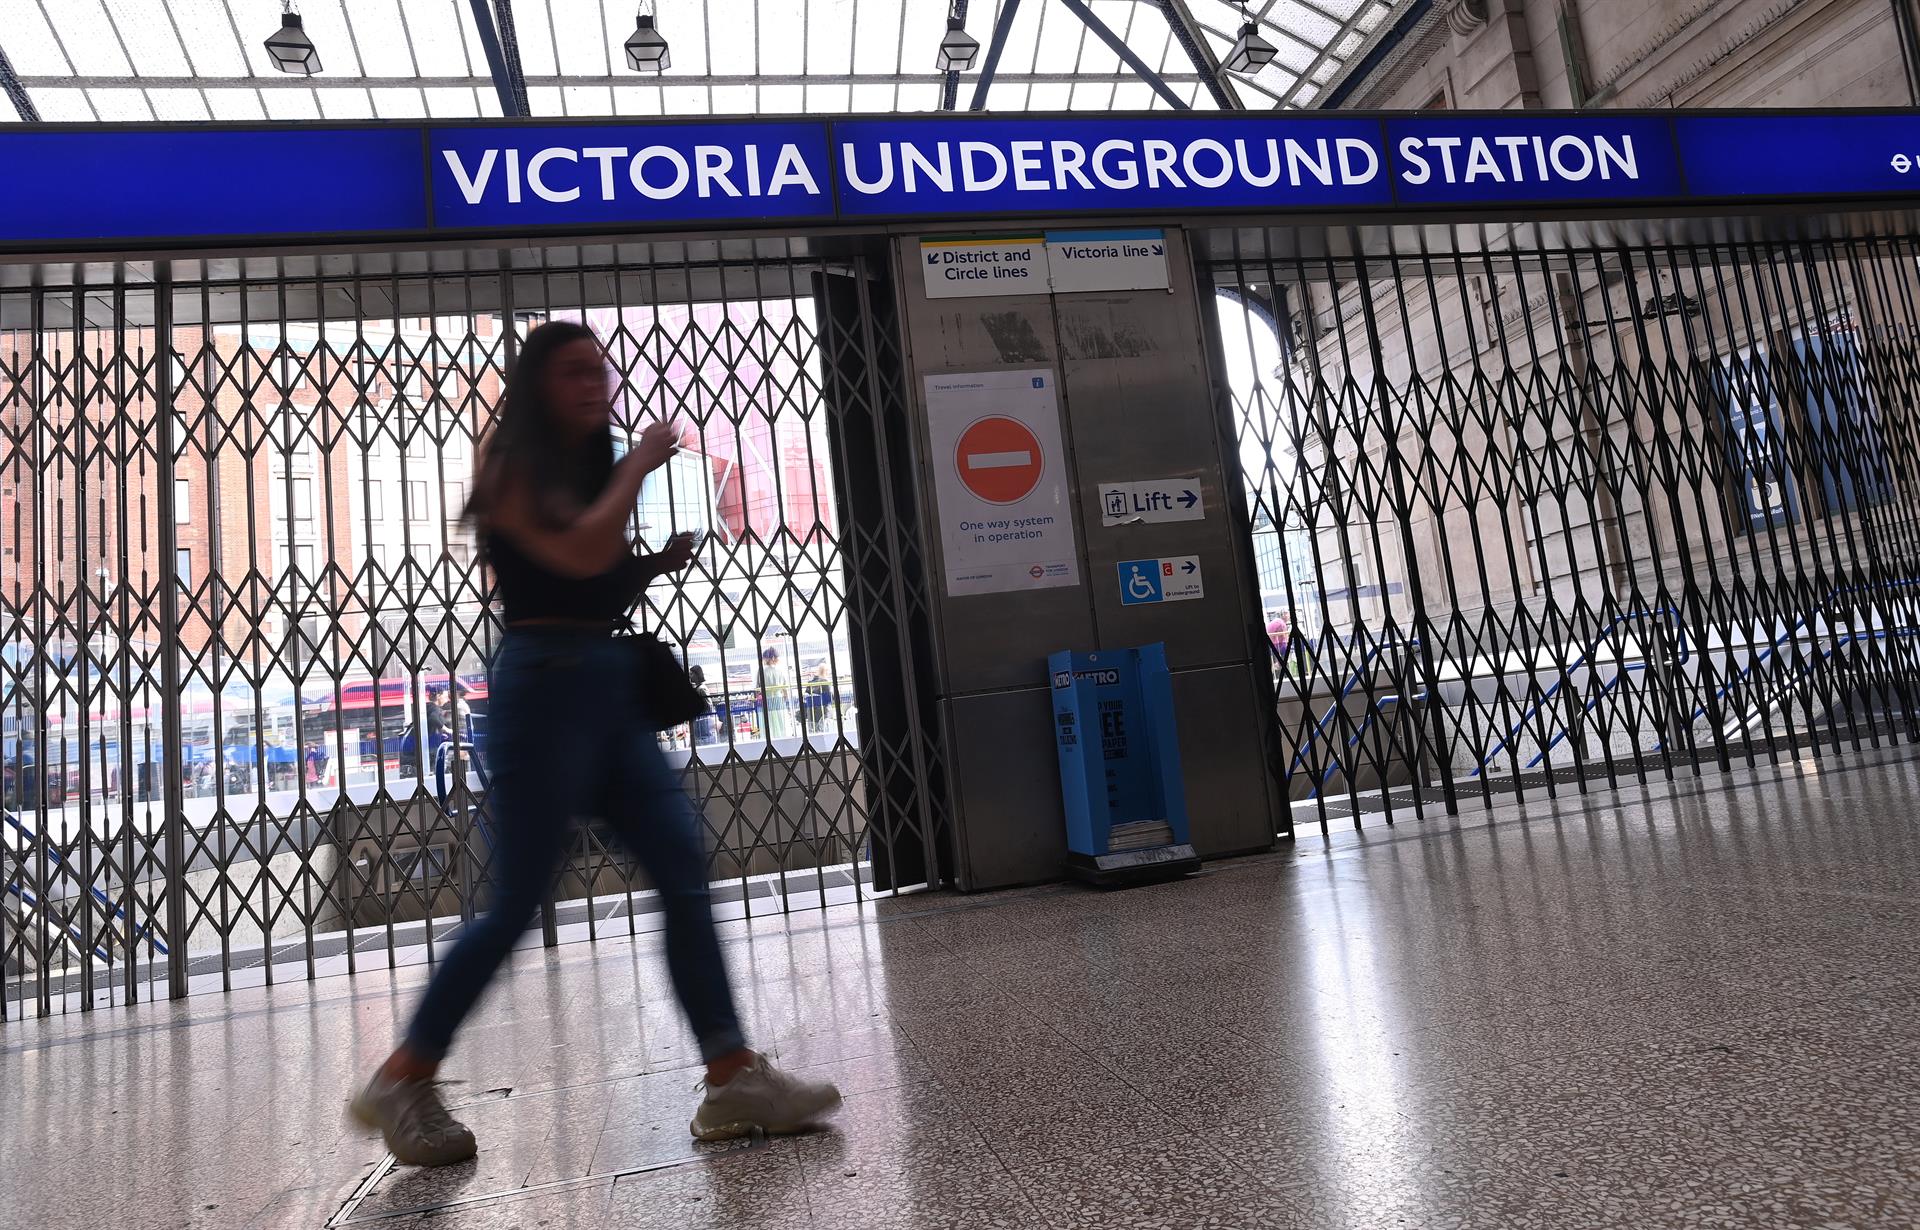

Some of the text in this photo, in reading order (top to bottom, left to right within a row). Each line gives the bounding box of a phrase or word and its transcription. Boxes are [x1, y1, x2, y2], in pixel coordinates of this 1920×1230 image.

[442, 134, 1639, 204] VICTORIA UNDERGROUND STATION
[943, 248, 1031, 264] District and
[1062, 244, 1149, 259] Victoria line
[944, 266, 1029, 280] Circle lines
[1133, 491, 1173, 512] Lift
[960, 516, 1054, 531] One way system
[974, 530, 1043, 544] in operation
[1171, 589, 1200, 597] Underground
[1054, 673, 1070, 688] METRO
